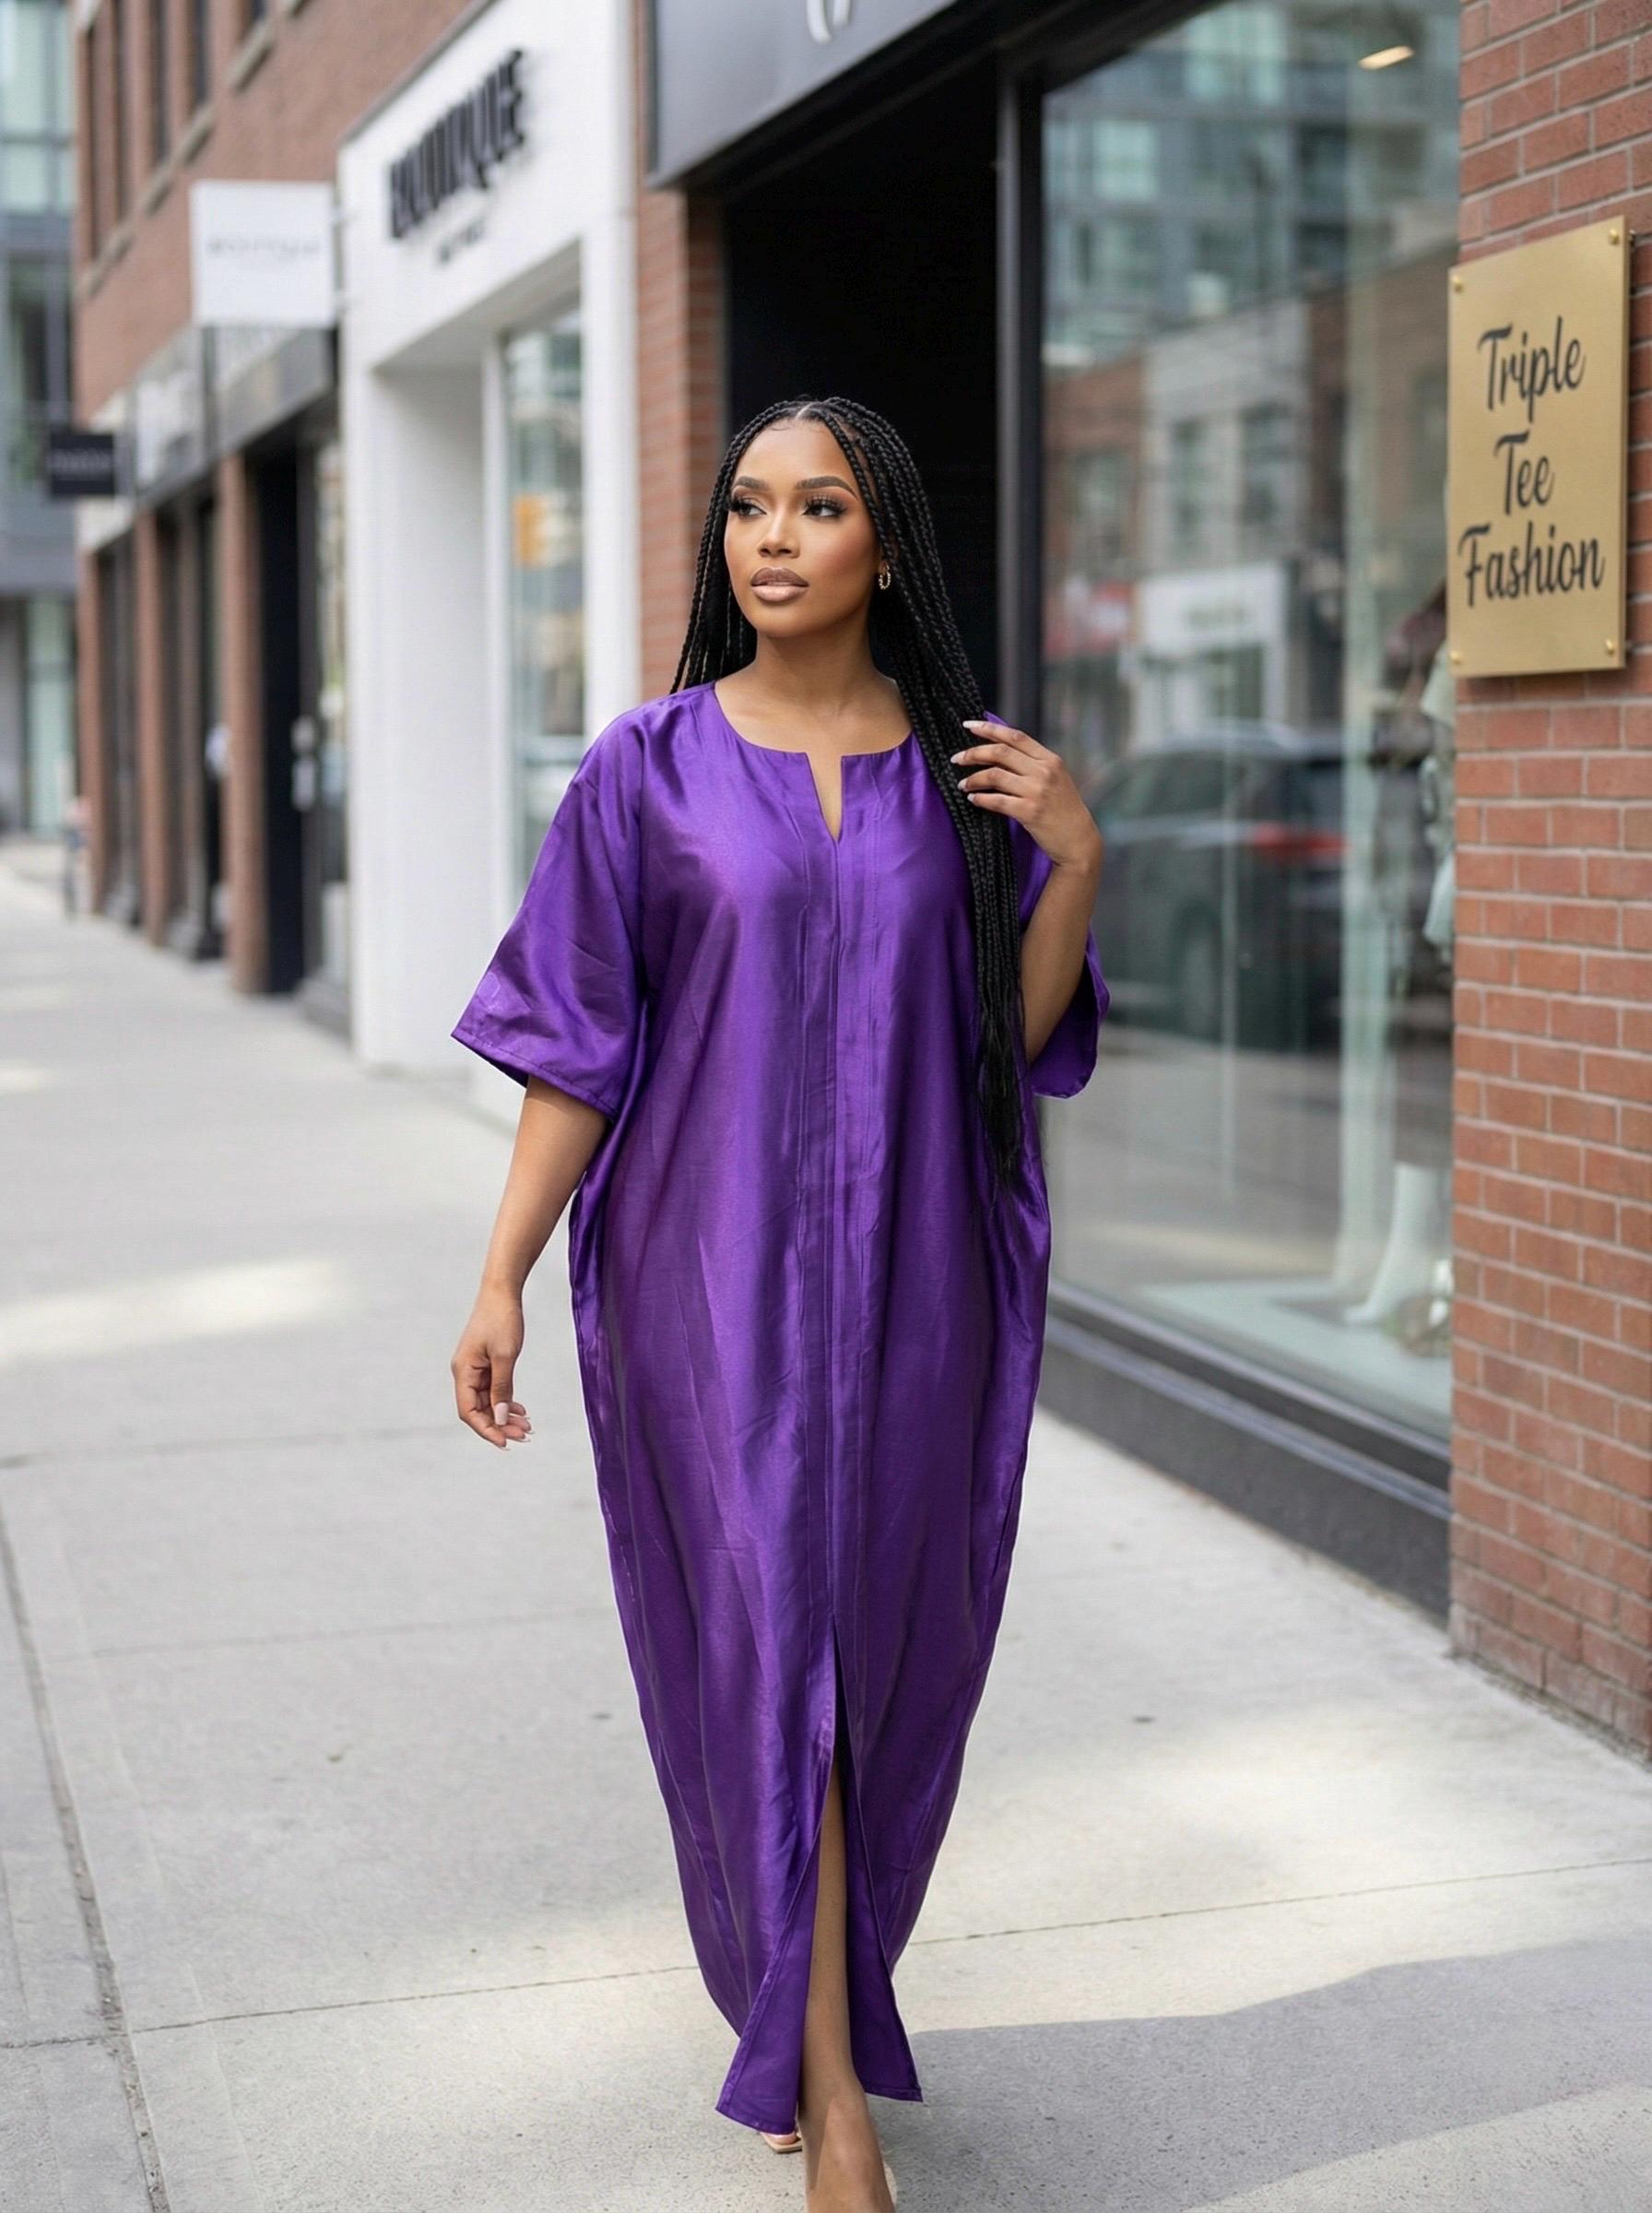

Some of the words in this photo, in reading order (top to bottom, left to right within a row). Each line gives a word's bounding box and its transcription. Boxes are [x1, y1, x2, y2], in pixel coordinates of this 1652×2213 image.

[1478, 315, 1586, 423] Triple
[1494, 429, 1556, 515] Tee
[1458, 520, 1605, 608] Fashion
